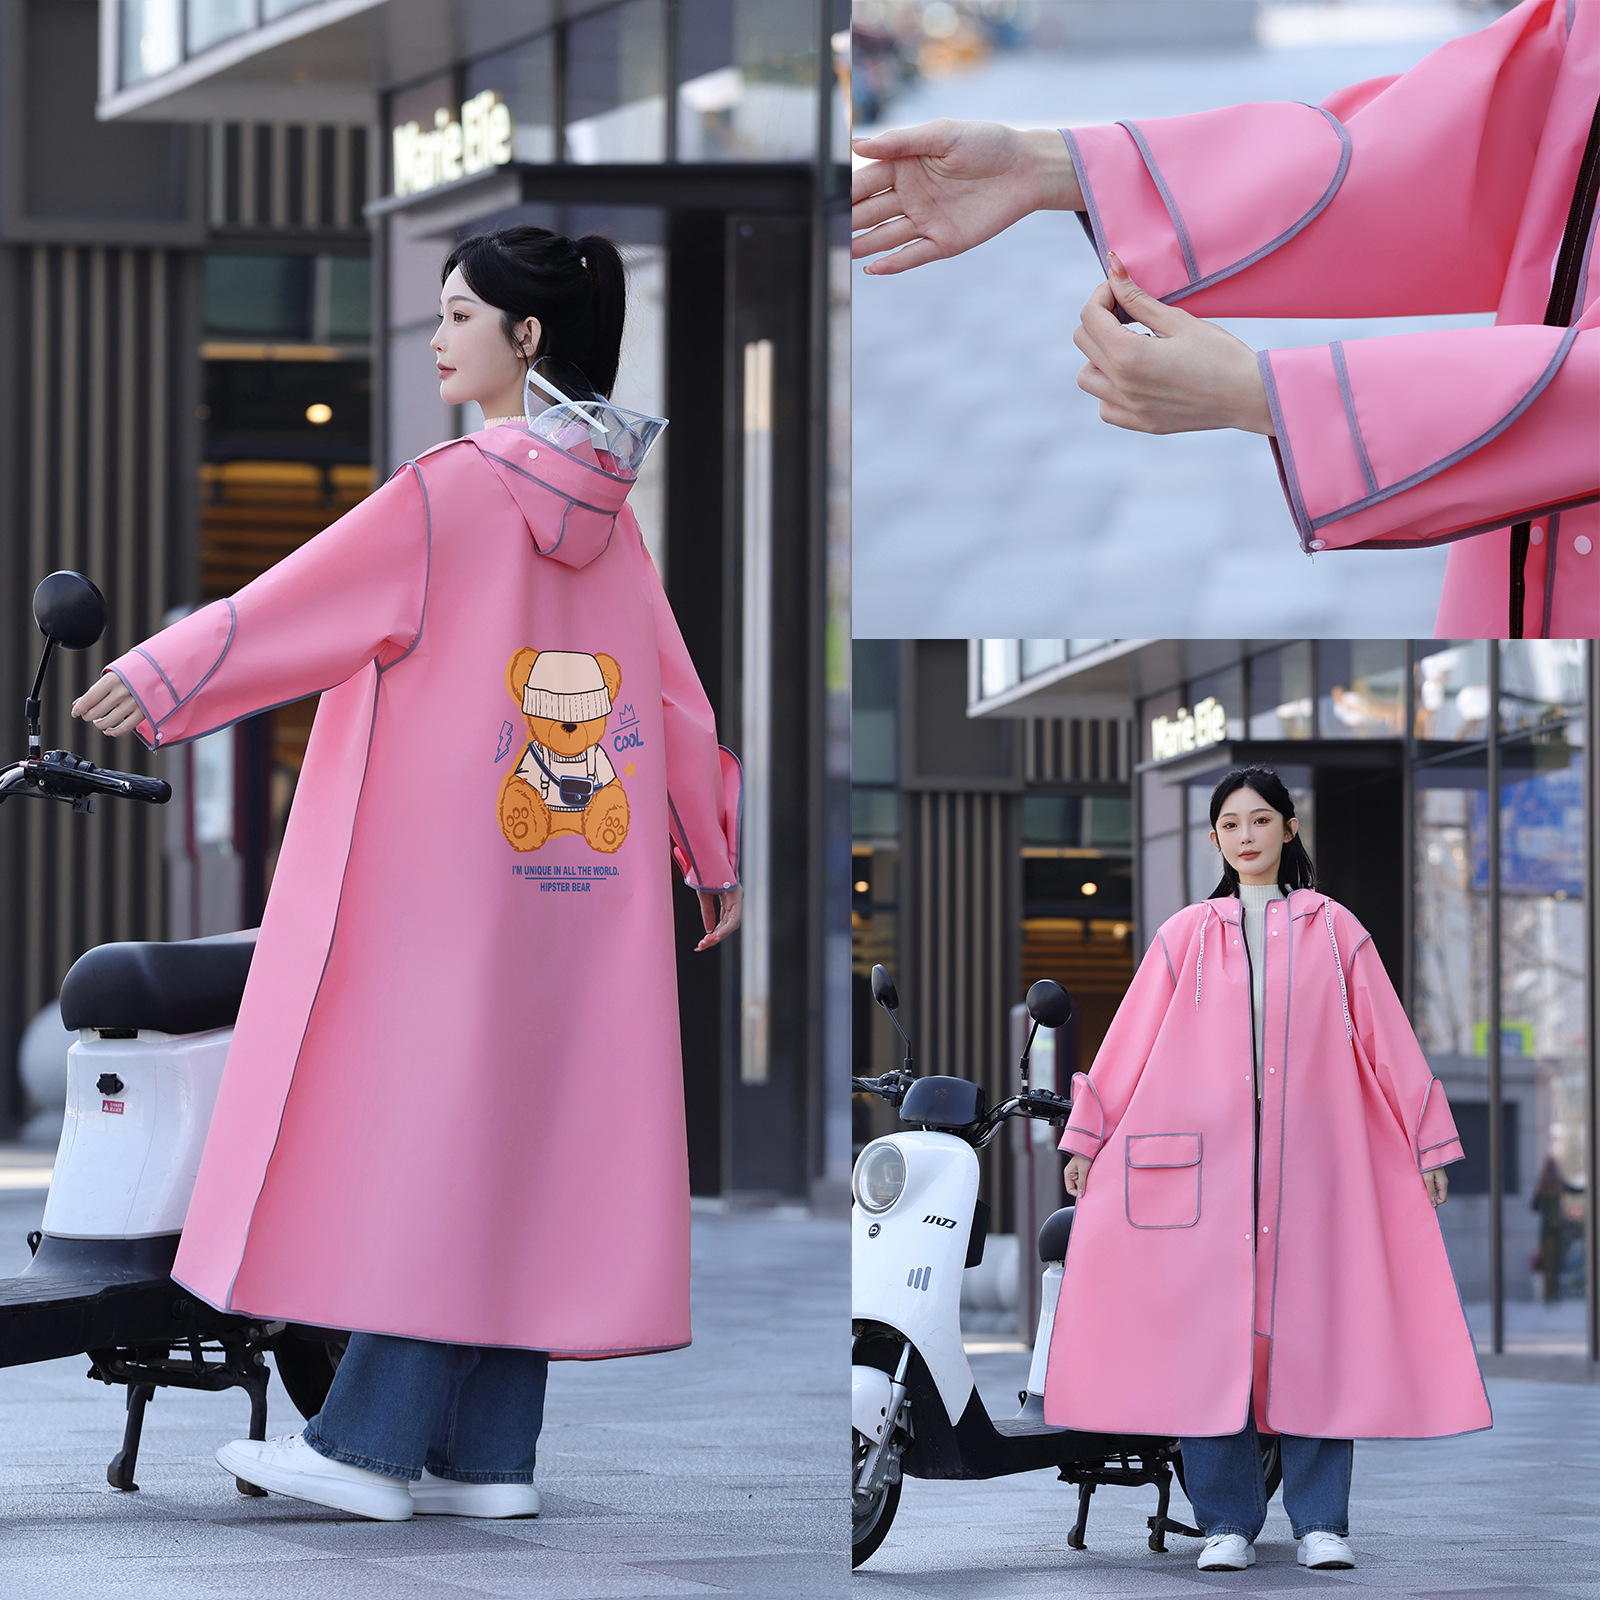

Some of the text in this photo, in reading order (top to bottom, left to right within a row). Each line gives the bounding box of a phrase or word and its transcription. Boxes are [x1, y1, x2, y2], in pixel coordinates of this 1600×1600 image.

[393, 107, 462, 198] Marie
[614, 727, 644, 752] COOL
[1152, 707, 1194, 761] Marie
[512, 866, 619, 875] I'M UNIQUE IN ALL THE WORLD.
[540, 882, 590, 892] HIPSTER BEAR
